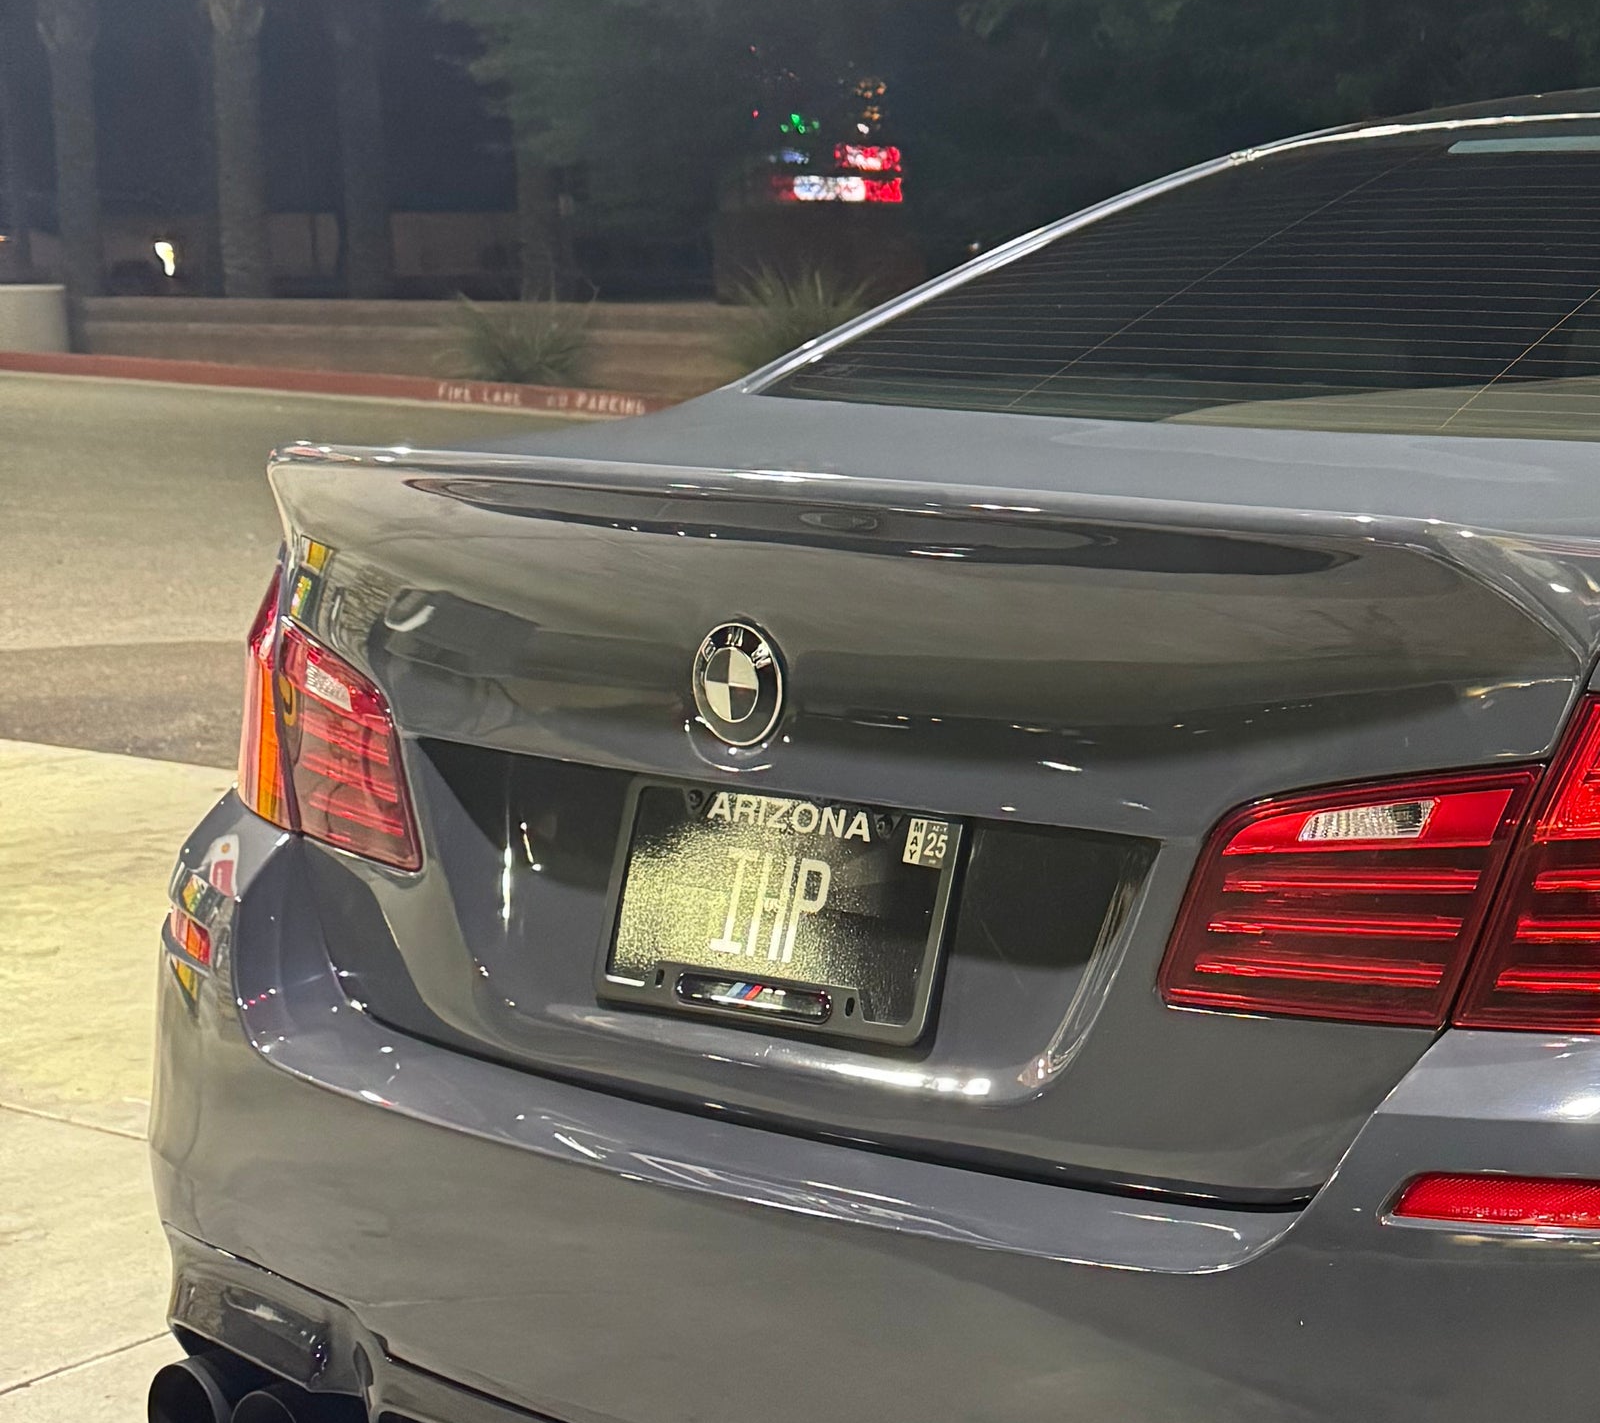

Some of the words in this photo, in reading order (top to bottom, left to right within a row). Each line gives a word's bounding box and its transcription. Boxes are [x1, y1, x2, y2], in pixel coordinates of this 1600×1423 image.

[575, 391, 646, 416] PARKING
[706, 791, 871, 842] ARIZONA
[908, 821, 924, 860] MAY
[923, 831, 949, 859] 25
